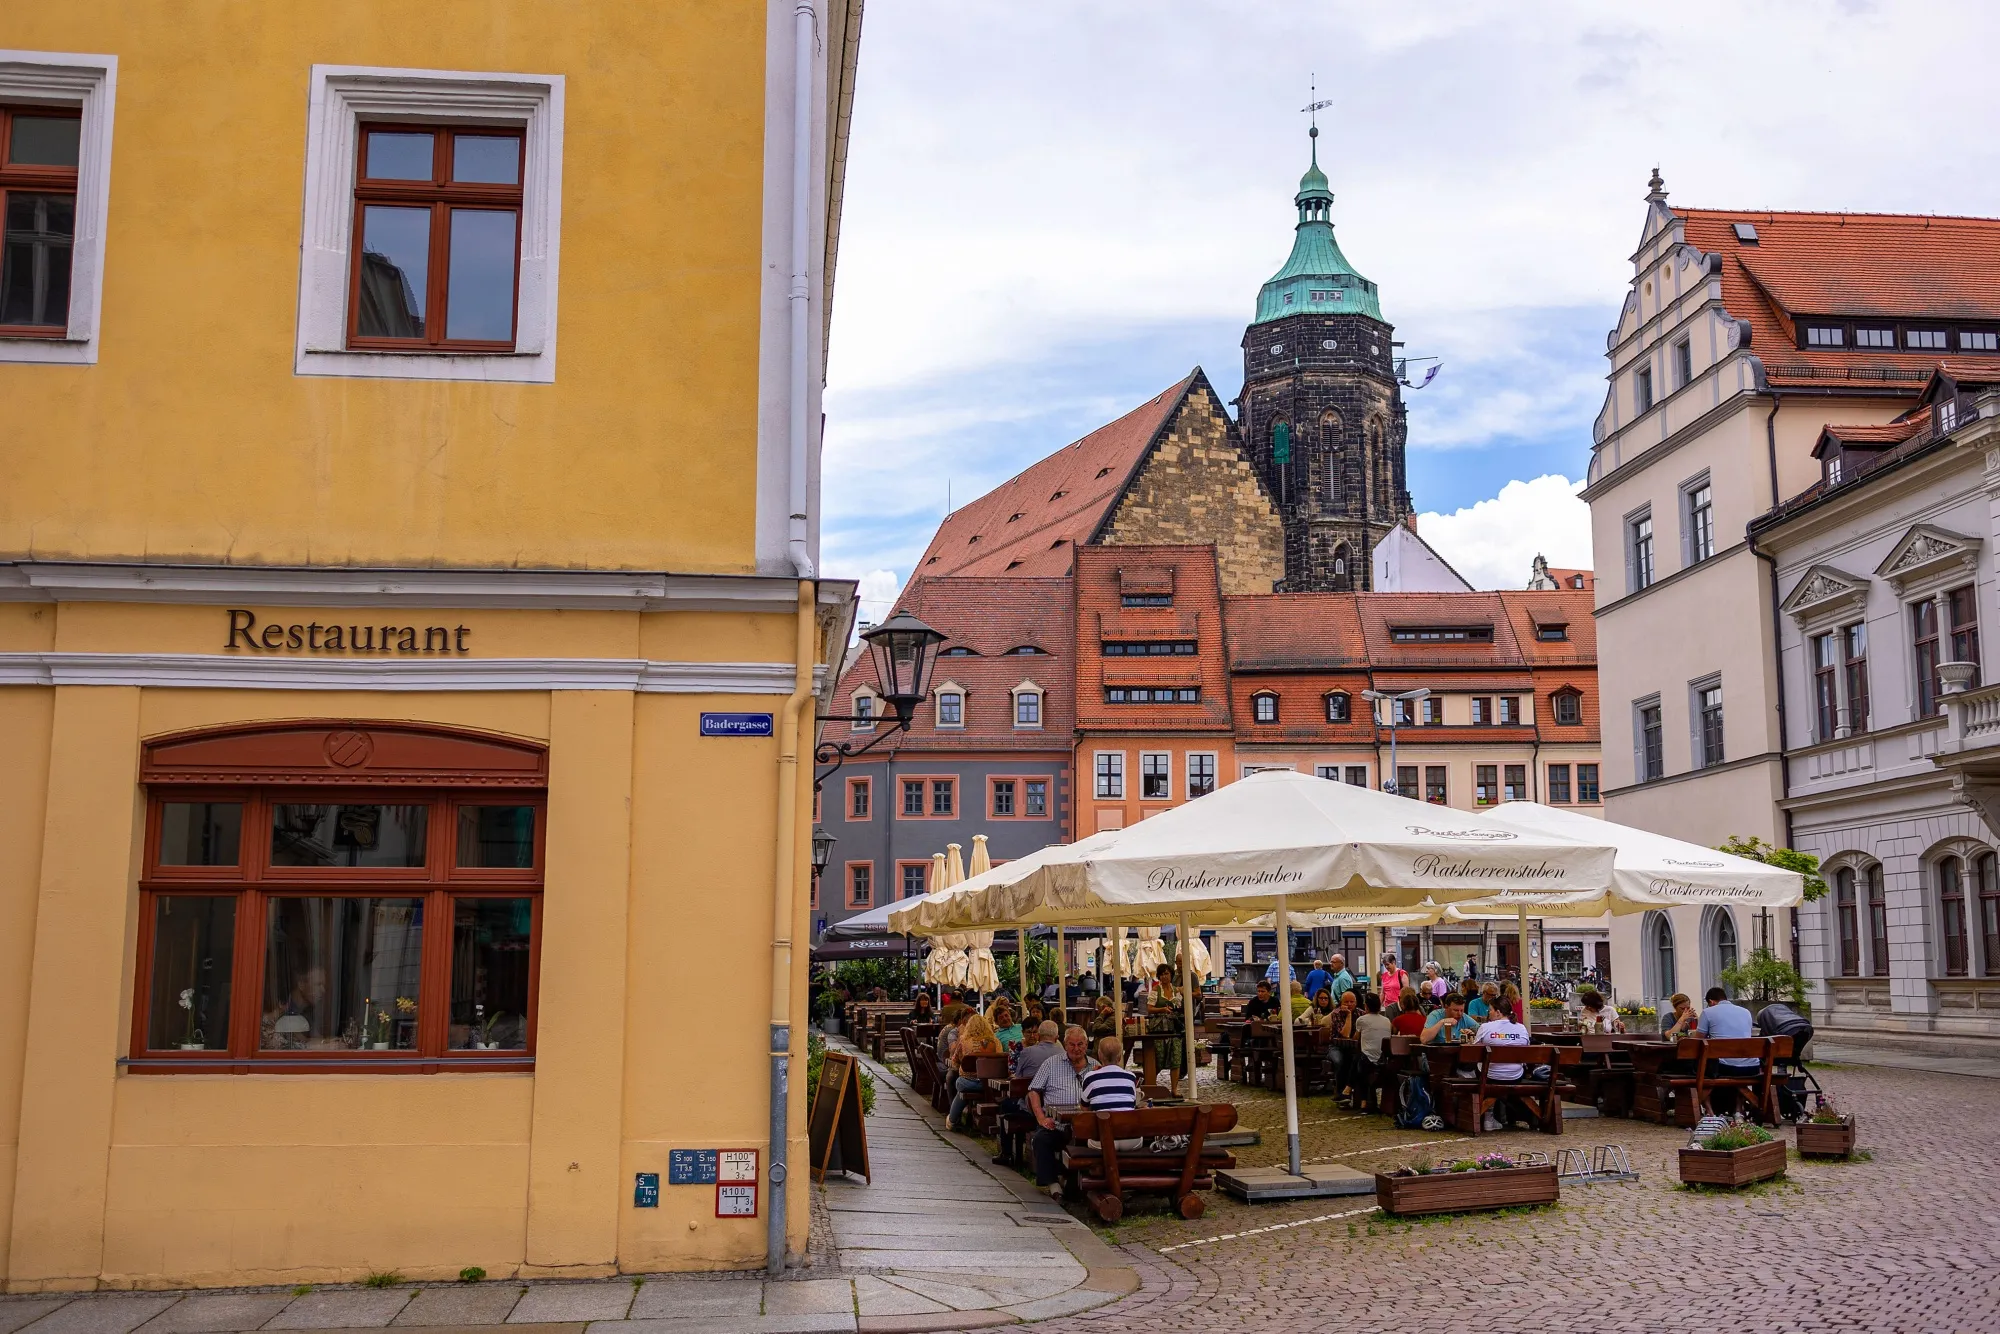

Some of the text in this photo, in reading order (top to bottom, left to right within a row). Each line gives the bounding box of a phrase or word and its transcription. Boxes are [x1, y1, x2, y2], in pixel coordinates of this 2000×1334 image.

[223, 609, 471, 653] Restaurant
[705, 719, 769, 731] Badergasse
[1413, 853, 1567, 879] Ratsherrenstuben
[1147, 865, 1304, 892] Ratsherrenstuben
[1649, 878, 1763, 898] Ratsherrenstuben
[1490, 1032, 1520, 1040] change
